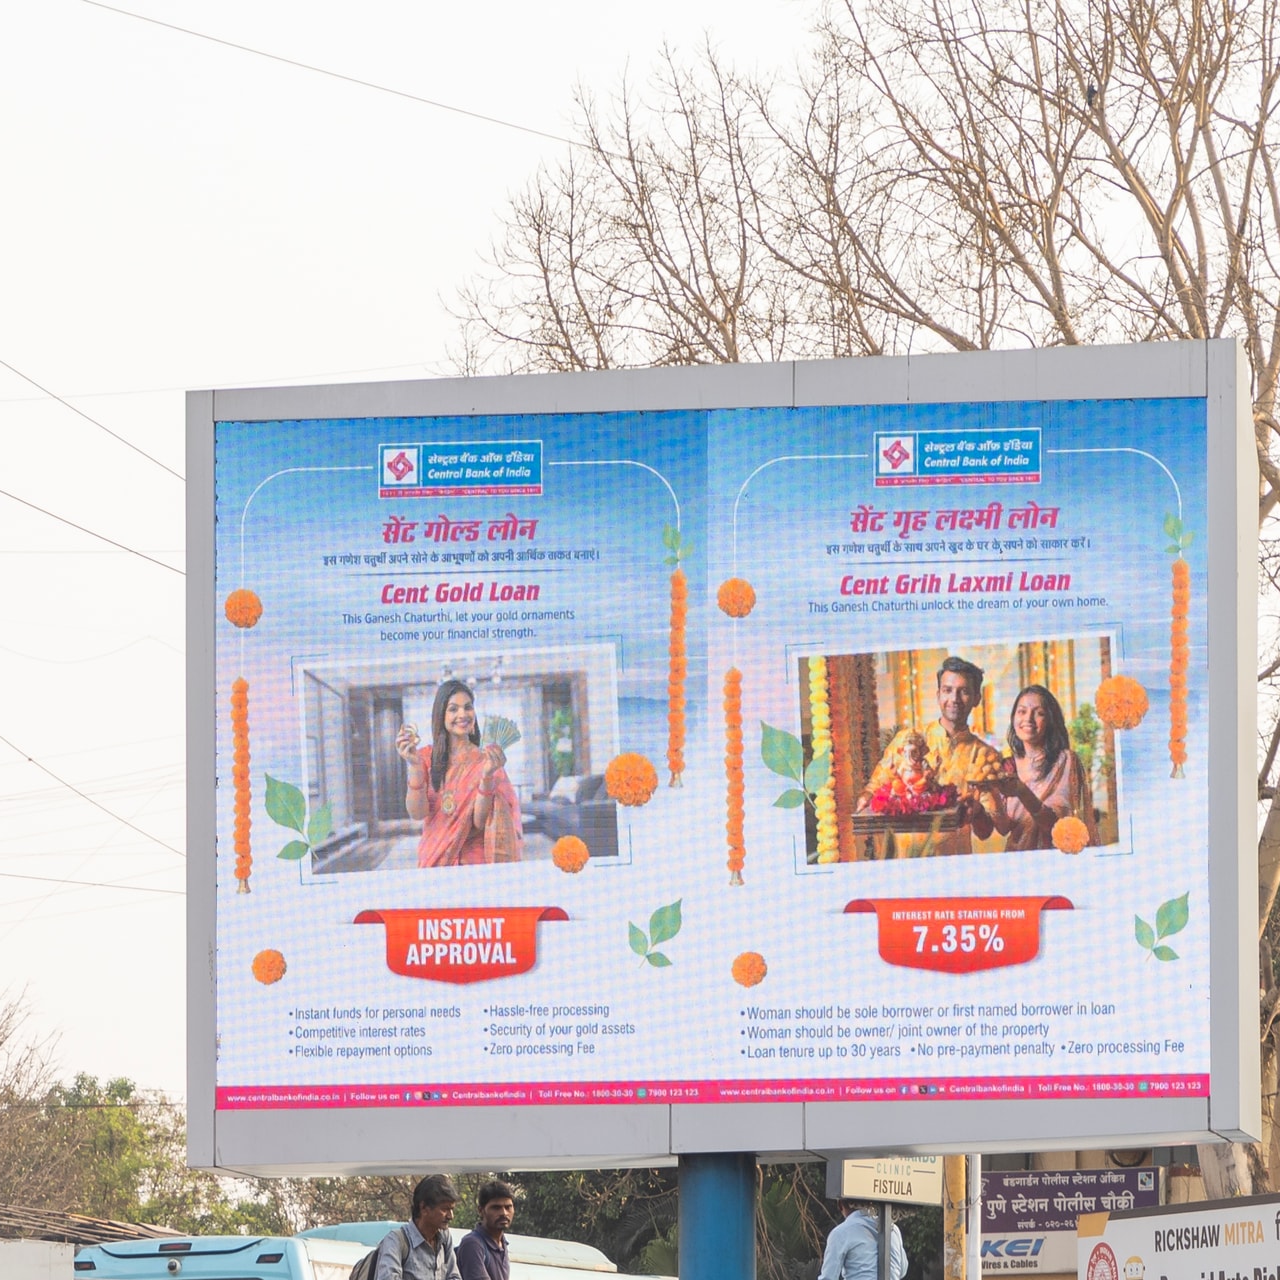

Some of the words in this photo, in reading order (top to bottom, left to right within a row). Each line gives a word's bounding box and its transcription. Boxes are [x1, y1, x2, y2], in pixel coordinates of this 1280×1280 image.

[428, 468, 463, 479] Central
[466, 467, 490, 478] Bank
[493, 467, 504, 478] of
[506, 466, 531, 477] India
[850, 504, 887, 532] सेंट
[893, 510, 930, 538] गृह
[935, 502, 1005, 531] लक्ष्मी
[1008, 501, 1060, 529] लोन
[382, 515, 418, 544] सेंट
[424, 514, 482, 542] गोल्ड
[487, 512, 538, 541] लोन
[840, 575, 889, 596] Cent
[895, 574, 942, 595] Grih
[947, 572, 1013, 593] Laxmi
[1019, 570, 1072, 591] Loan
[381, 583, 430, 604] Cent
[435, 582, 484, 603] Gold
[489, 581, 540, 602] Loan
[342, 614, 362, 624] This
[364, 613, 401, 624] Ganesh
[404, 611, 452, 623] Chaturthi,
[456, 611, 469, 622] let
[471, 612, 493, 624] your
[496, 610, 518, 623] gold
[521, 610, 575, 621] ornaments
[381, 631, 420, 641] become
[422, 631, 445, 642] your
[448, 629, 489, 640] financial
[492, 628, 537, 640] strength.
[892, 911, 932, 920] INTEREST
[934, 910, 955, 920] RATE
[958, 910, 998, 919] STARTING
[1000, 909, 1025, 919] FROM
[418, 918, 505, 941] INSTANT
[912, 924, 1005, 953] 7.35%
[406, 940, 517, 965] APPROVAL
[295, 1008, 330, 1020] Instant
[333, 1007, 362, 1019] funds
[365, 1006, 379, 1019] for
[382, 1006, 426, 1020] personal
[430, 1006, 461, 1018] needs
[489, 1004, 549, 1017] Hassle-free
[552, 1004, 610, 1018] processing
[295, 1025, 356, 1040] Competitive
[359, 1026, 397, 1038] interest
[400, 1026, 426, 1037] rates
[489, 1023, 532, 1038] Security
[535, 1023, 547, 1035] of
[549, 1025, 572, 1038] your
[576, 1023, 598, 1037] gold
[601, 1023, 635, 1035] assets
[295, 1045, 333, 1058] Flexible
[336, 1045, 391, 1060] repayment
[394, 1044, 432, 1059] options
[489, 1043, 513, 1055] Zero
[516, 1042, 574, 1057] processing
[577, 1042, 595, 1054] Fee
[876, 1162, 912, 1177] CLINIC
[873, 1179, 913, 1197] FISTULA
[986, 1194, 1007, 1219] पुणे
[1011, 1192, 1048, 1214] स्टेशन
[1053, 1190, 1096, 1212] पोलीस
[1101, 1189, 1135, 1211] चौकी
[1154, 1224, 1220, 1252] RICKSHAW
[1224, 1220, 1264, 1246] MITRA
[980, 1238, 1045, 1258] KEI
[1010, 1259, 1038, 1270] Cables
